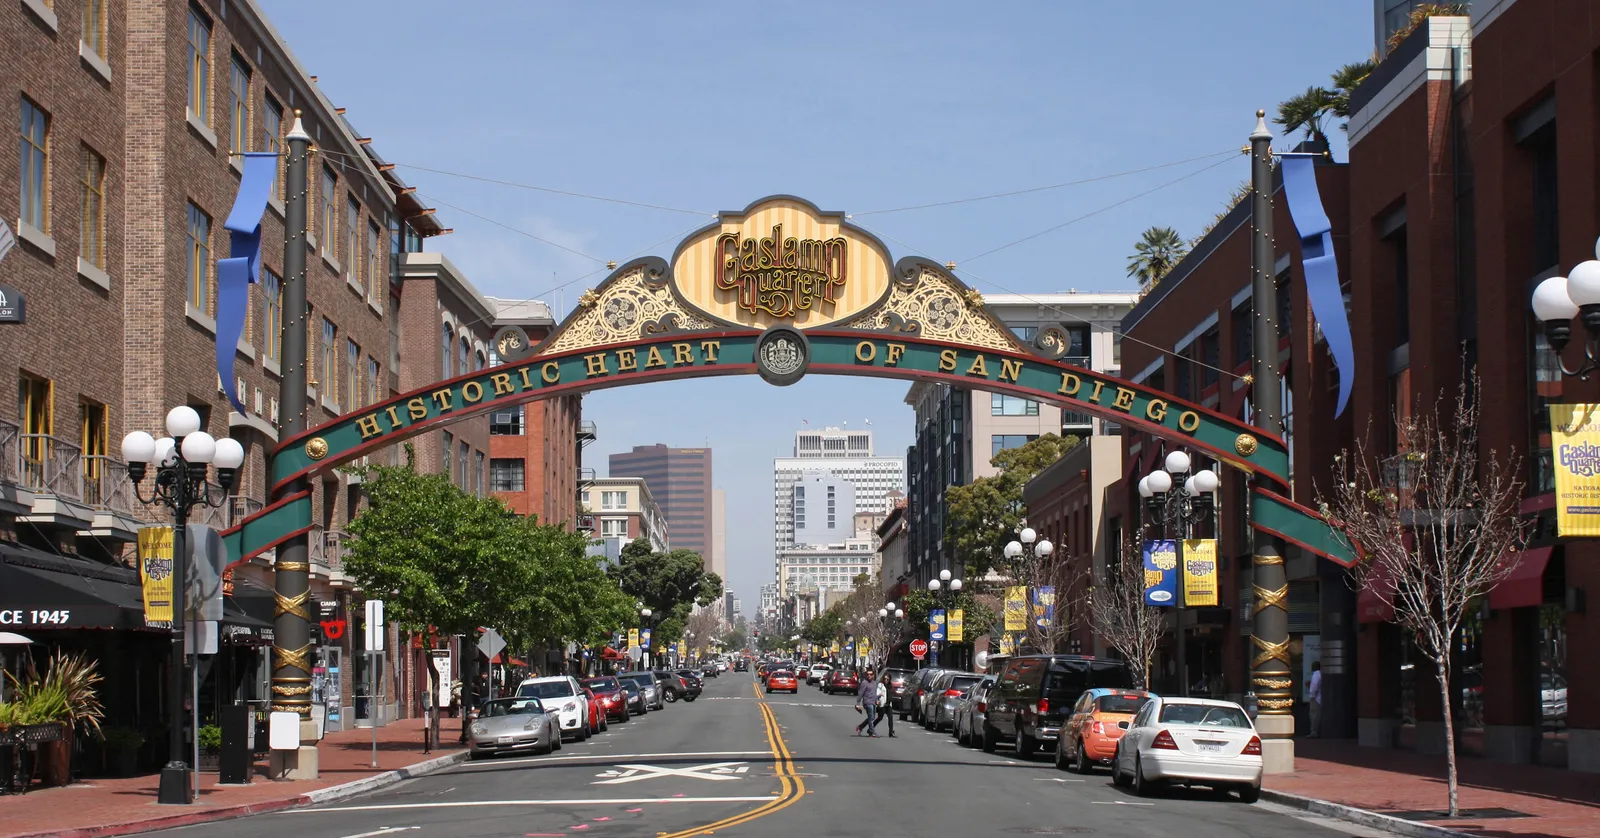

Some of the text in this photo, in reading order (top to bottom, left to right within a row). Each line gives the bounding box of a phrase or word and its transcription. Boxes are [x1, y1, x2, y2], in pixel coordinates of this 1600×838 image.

[716, 223, 848, 305] Gaslamp
[736, 269, 827, 317] Quarter
[355, 361, 561, 440] HISTORIC
[583, 340, 721, 376] HEART
[855, 340, 905, 364] OF
[939, 349, 1024, 382] SAN
[1057, 372, 1201, 433] DIEGO
[0, 610, 70, 624] CE 1945
[911, 644, 926, 652] STOP
